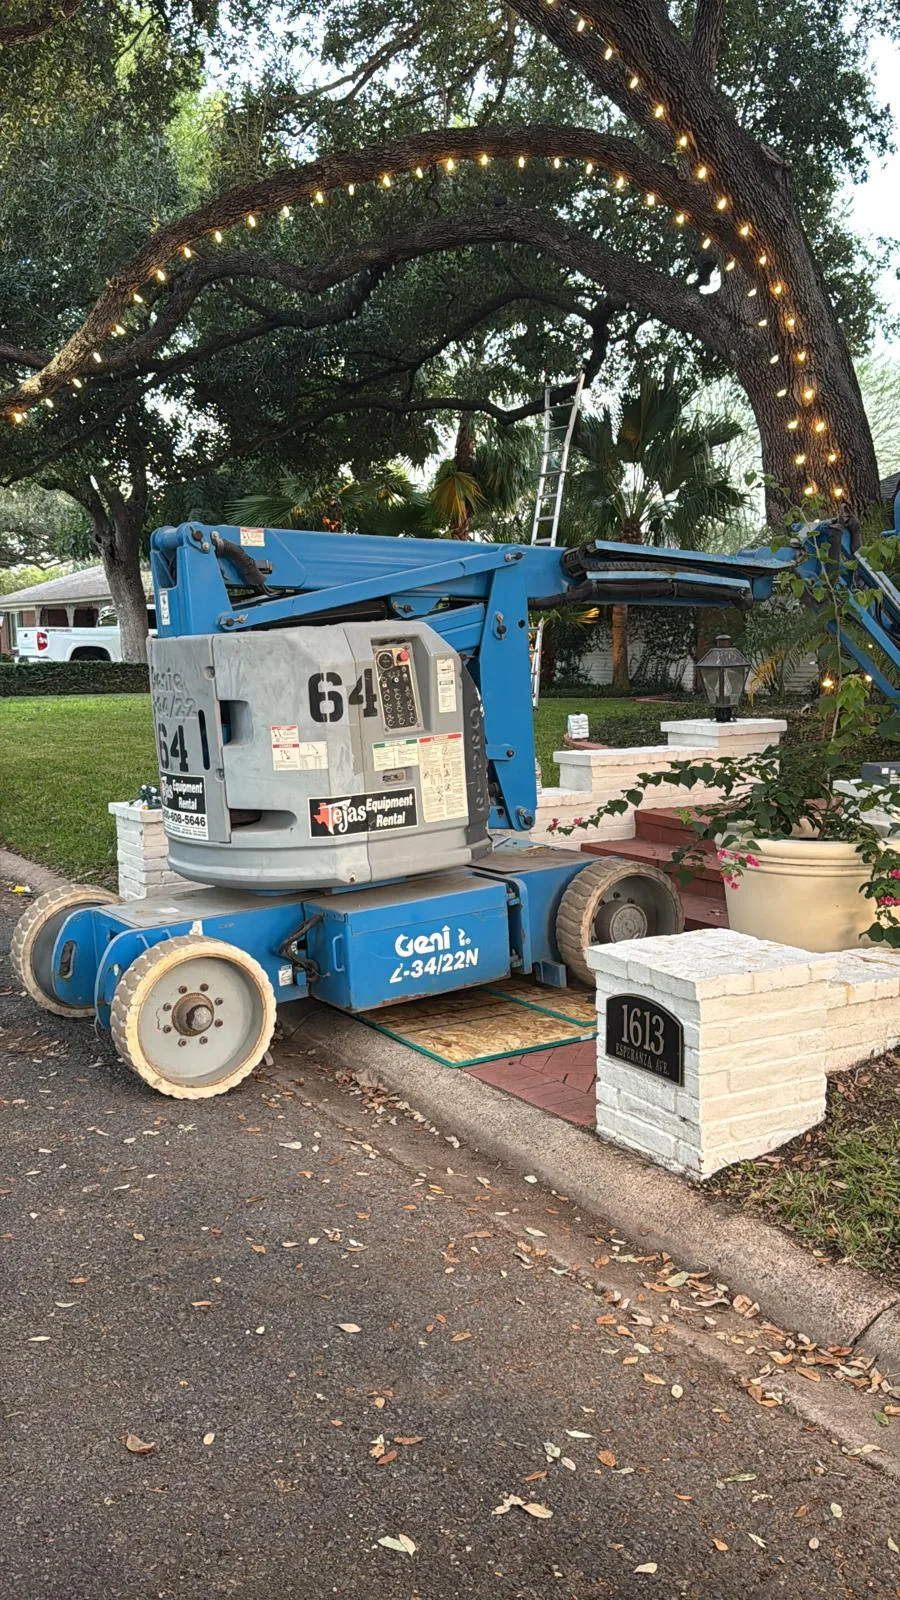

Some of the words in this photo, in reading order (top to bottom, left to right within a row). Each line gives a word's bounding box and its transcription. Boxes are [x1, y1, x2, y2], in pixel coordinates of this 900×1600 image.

[308, 668, 378, 723] 64
[158, 722, 189, 772] 64
[172, 779, 203, 796] Equipment
[178, 796, 198, 811] Rental
[318, 799, 367, 835] Tejas
[365, 793, 413, 813] Equipment
[376, 807, 406, 828] Rental
[621, 1004, 665, 1056] 1613
[615, 1042, 653, 1071] ESPERANZA
